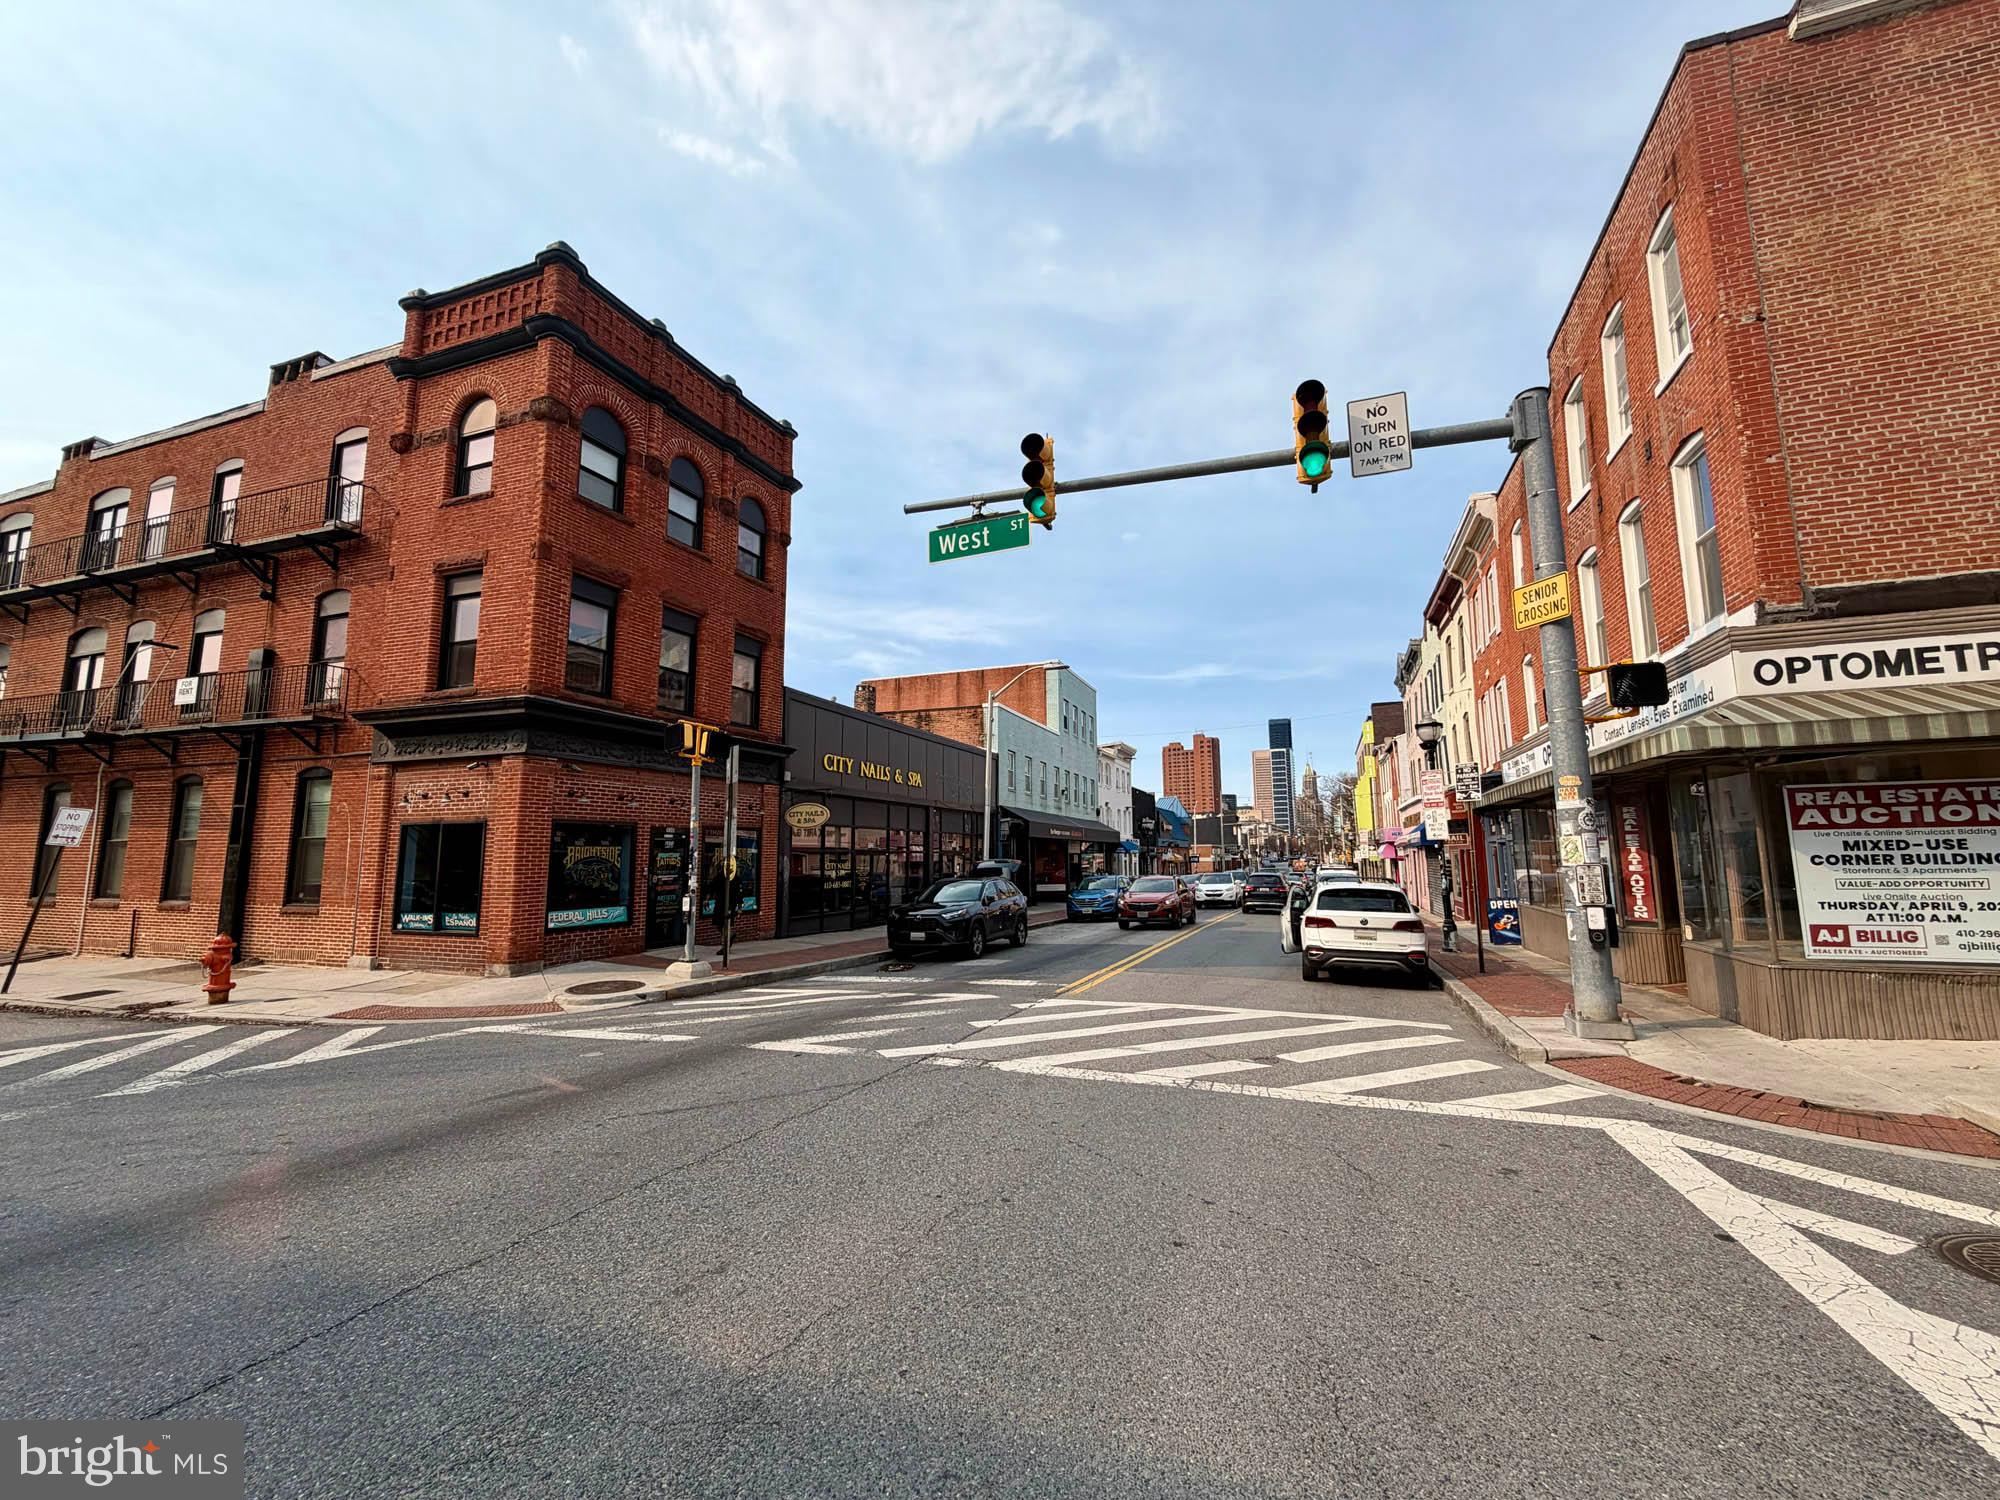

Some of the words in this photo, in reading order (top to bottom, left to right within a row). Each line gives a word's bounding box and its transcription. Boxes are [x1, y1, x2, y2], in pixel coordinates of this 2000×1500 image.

[1366, 406, 1388, 419] NO
[1361, 420, 1397, 436] TURN
[1354, 440, 1373, 454] ON
[1379, 436, 1406, 450] RED
[1360, 453, 1404, 467] 7AM-7PM
[938, 526, 990, 555] West
[1010, 518, 1024, 530] ST
[1522, 582, 1558, 606] SENIOR
[1518, 597, 1566, 624] CROSSING
[1754, 642, 2000, 686] OPTOMETR
[1668, 680, 1688, 698] enter
[1604, 724, 1624, 742] Contact
[1626, 716, 1650, 733] Lenses
[1654, 707, 1670, 724] Eyes
[1672, 686, 1714, 715] Examined
[824, 754, 854, 774] CITY
[860, 762, 890, 781] NAILS
[894, 769, 903, 784] &
[908, 771, 922, 787] SPA
[1795, 791, 1871, 806] REAL
[1880, 786, 2000, 804] ESTATE
[1622, 806, 1640, 832] REAL
[1798, 804, 2000, 825] AUCTION
[55, 824, 83, 832] STOPPING
[1958, 828, 1996, 836] Bidding
[1843, 838, 1969, 852] MIXED-USE
[563, 846, 622, 869] BRIGHTSIDE
[1810, 854, 1895, 866] CORNER
[1839, 880, 1901, 888] VALUE-ADD
[1490, 900, 1518, 909] OPEN
[1630, 874, 1648, 918] AUCTION
[548, 911, 584, 922] FEDERAL
[586, 908, 608, 920] HILLS
[1818, 901, 1904, 912] THURSDAY,
[1909, 902, 1956, 911] APRIL
[1959, 902, 1973, 911] 9,
[1866, 914, 1885, 922] AT
[1889, 913, 1925, 922] 11:00
[1929, 914, 1968, 923] A.M.
[1817, 928, 1844, 942] AJ
[1856, 930, 1918, 943] BILLIG
